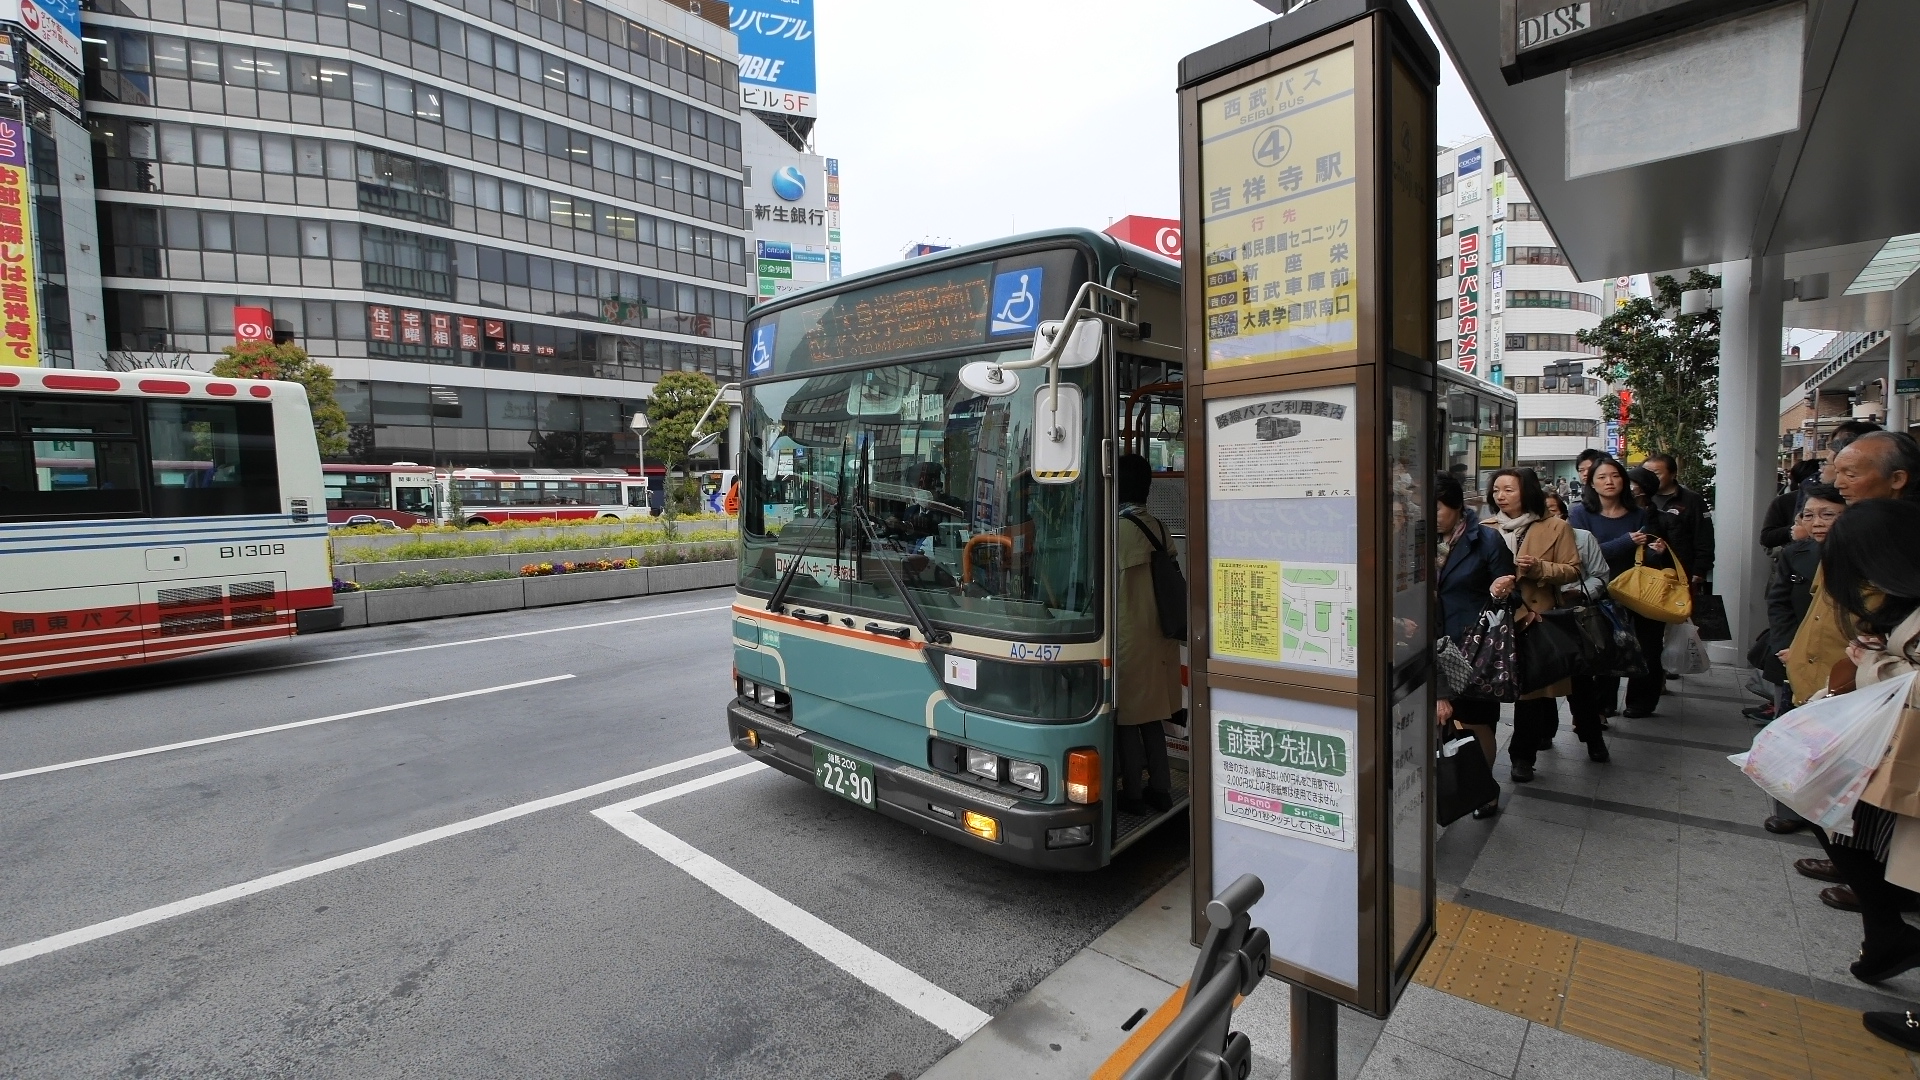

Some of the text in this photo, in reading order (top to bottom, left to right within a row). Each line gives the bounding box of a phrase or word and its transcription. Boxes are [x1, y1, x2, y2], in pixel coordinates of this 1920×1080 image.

[744, 88, 809, 112] ビル 5F
[1224, 68, 1322, 120] 西武バス
[1240, 96, 1304, 124] SEIBU BUS
[1210, 151, 1342, 214] 吉祥寺駅
[755, 204, 824, 226] 新生銀行
[1251, 208, 1296, 232] 行先
[1242, 219, 1349, 260] 都民農園セコニック
[0, 167, 32, 358] お部屋探しは吉祥寺で
[1243, 242, 1349, 282] 新座栄
[1210, 271, 1236, 285] 吉61-1
[1243, 267, 1349, 305] 西武車庫前
[1211, 294, 1235, 307] 吉62
[1243, 295, 1349, 330] 大泉学園駅南口
[1459, 233, 1478, 374] ヨドバシカメラ
[374, 308, 502, 335] 住宅ローン
[375, 324, 477, 348] 土曜相談
[497, 341, 555, 355] 予約受付中
[1217, 400, 1345, 428] 路線バスご利用案内
[1305, 489, 1351, 497] 西武バス
[220, 543, 285, 558] B1308
[12, 609, 136, 635] 関東バス
[1010, 642, 1062, 661] AO-457
[1227, 725, 1336, 768] 前乗り 先払い
[824, 763, 871, 803] 22-90
